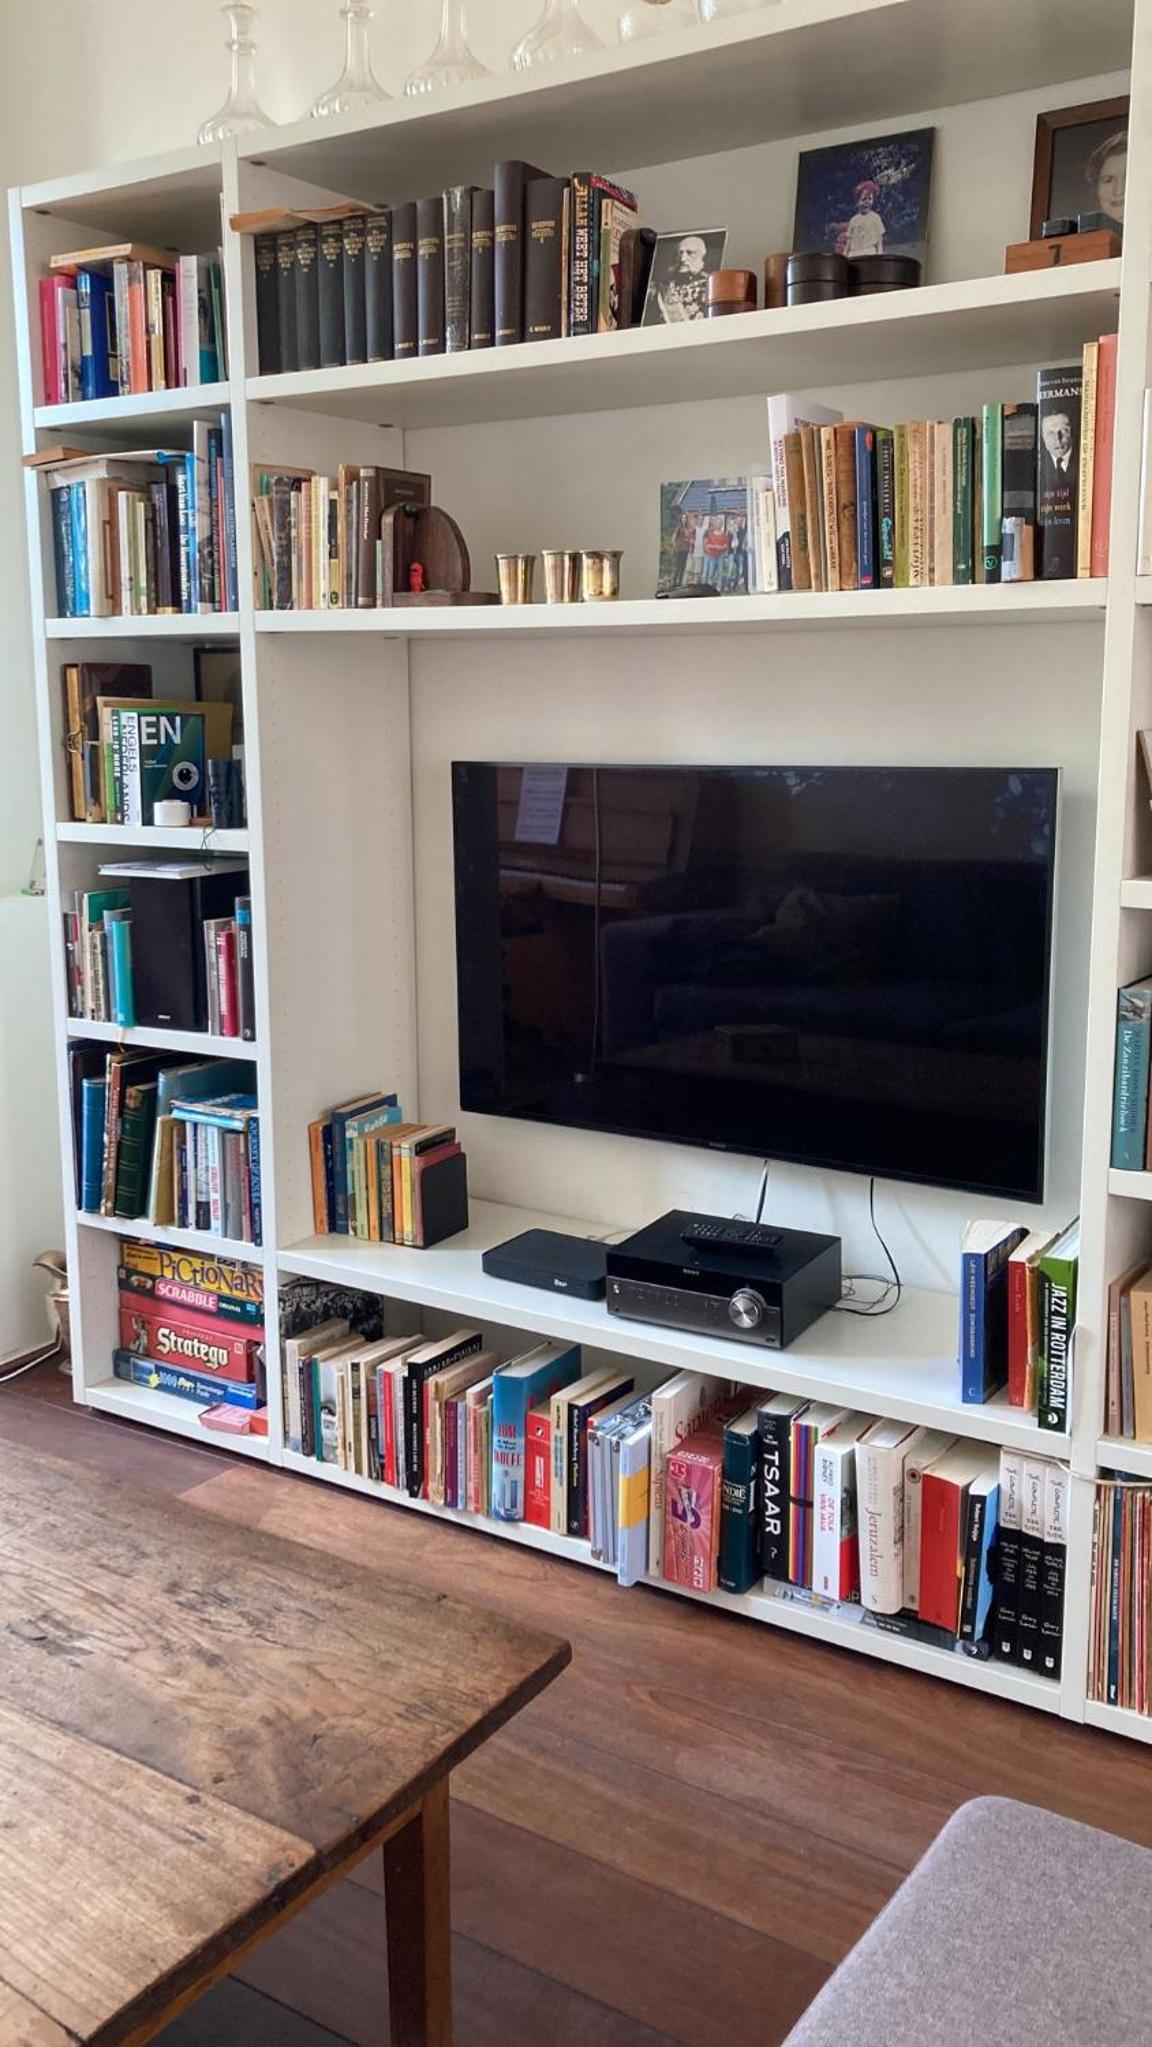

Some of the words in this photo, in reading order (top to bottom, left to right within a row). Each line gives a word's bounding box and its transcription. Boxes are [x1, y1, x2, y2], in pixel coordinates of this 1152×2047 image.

[575, 228, 588, 258] WEET
[575, 260, 588, 283] HET
[575, 285, 588, 321] BETER
[126, 716, 138, 773] ENGELS
[140, 716, 181, 745] EN
[1123, 1030, 1133, 1044] De
[249, 1120, 258, 1159] JOURNEY
[251, 1163, 258, 1173] OF
[251, 1176, 260, 1203] SOULS
[158, 1283, 216, 1309] SCRABBLE
[1050, 1282, 1068, 1312] JAZZ
[1050, 1316, 1067, 1331] IN
[157, 1327, 229, 1369] Stratego
[1049, 1332, 1067, 1409] ROTTERDAM
[763, 1450, 782, 1536] TSAAR
[865, 1507, 884, 1577] Jeruzalem
